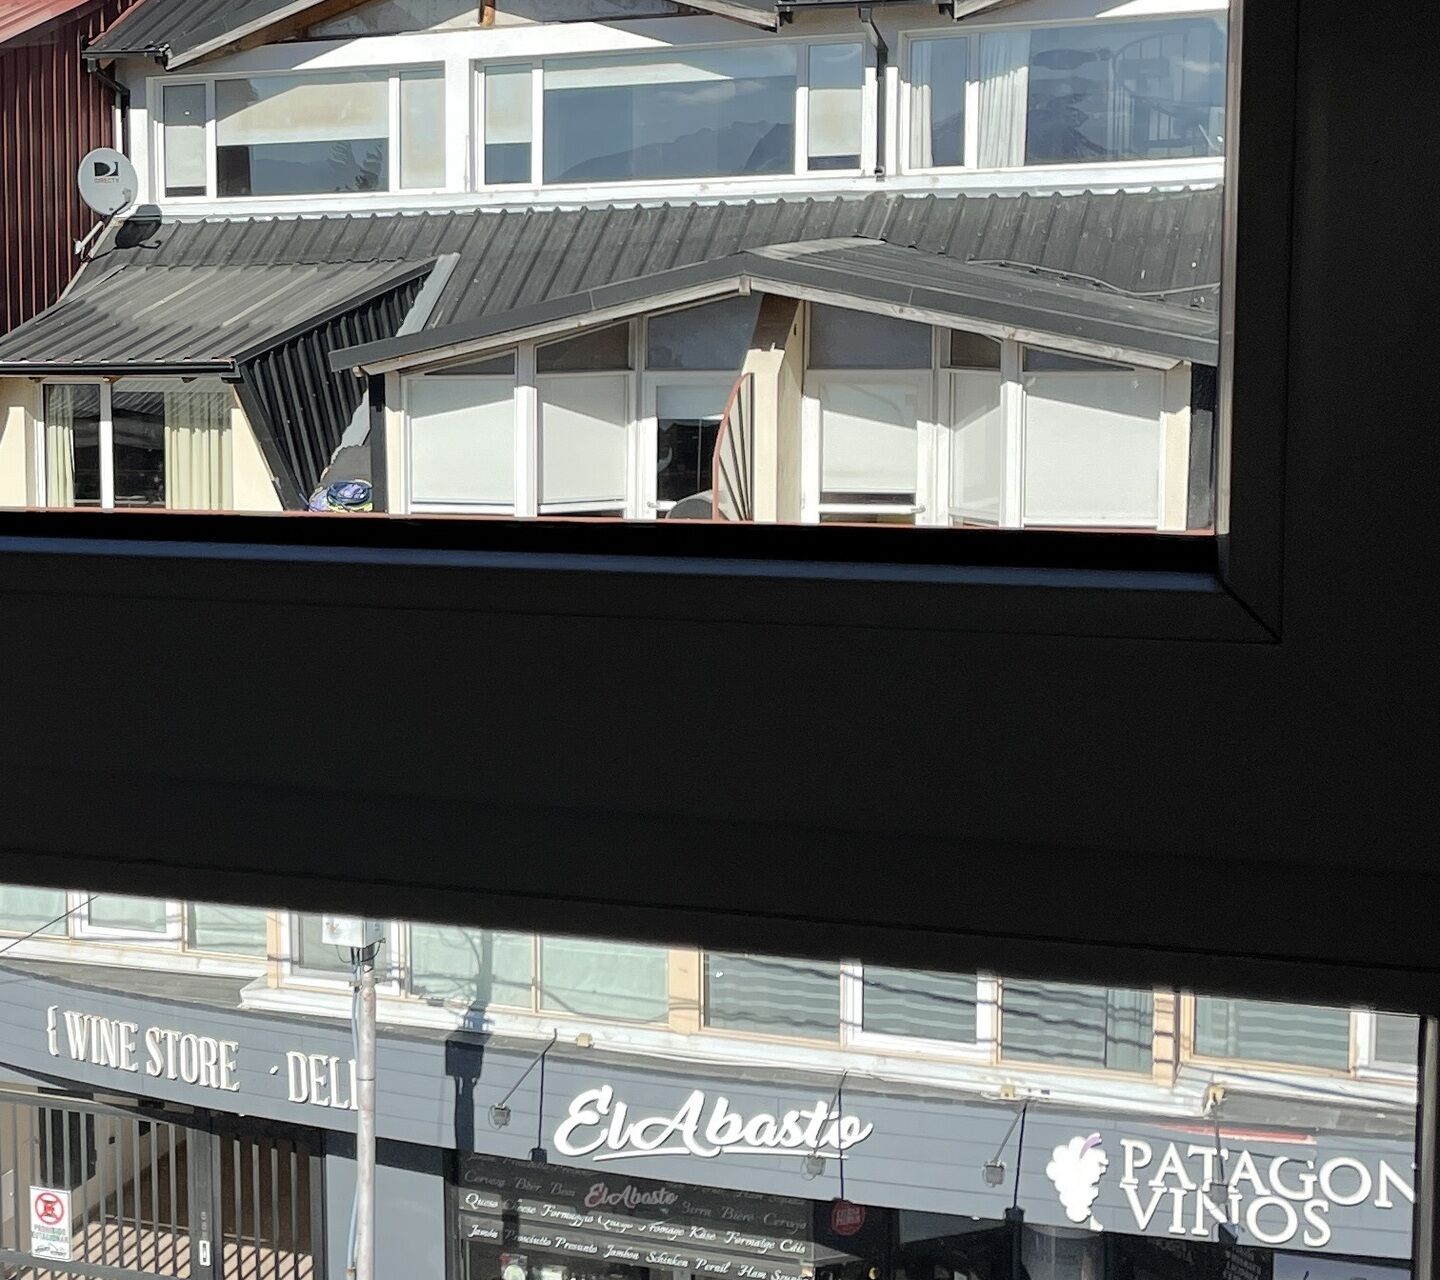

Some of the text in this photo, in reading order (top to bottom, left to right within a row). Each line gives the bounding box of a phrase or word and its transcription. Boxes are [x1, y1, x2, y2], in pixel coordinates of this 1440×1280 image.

[63, 1009, 139, 1072] WINE
[145, 1026, 241, 1092] STORE
[285, 1050, 359, 1111] DELI
[465, 1192, 499, 1210] Queso
[688, 1225, 717, 1241] Käse
[723, 1230, 776, 1255] Formatge
[1119, 1181, 1333, 1248] VINOS
[467, 1224, 499, 1239] Jamón
[554, 1235, 599, 1254] Presunto
[603, 1244, 640, 1260] Jambon
[645, 1250, 690, 1269] Schinken
[695, 1257, 732, 1274] Pernil
[737, 1264, 768, 1280] Ham
